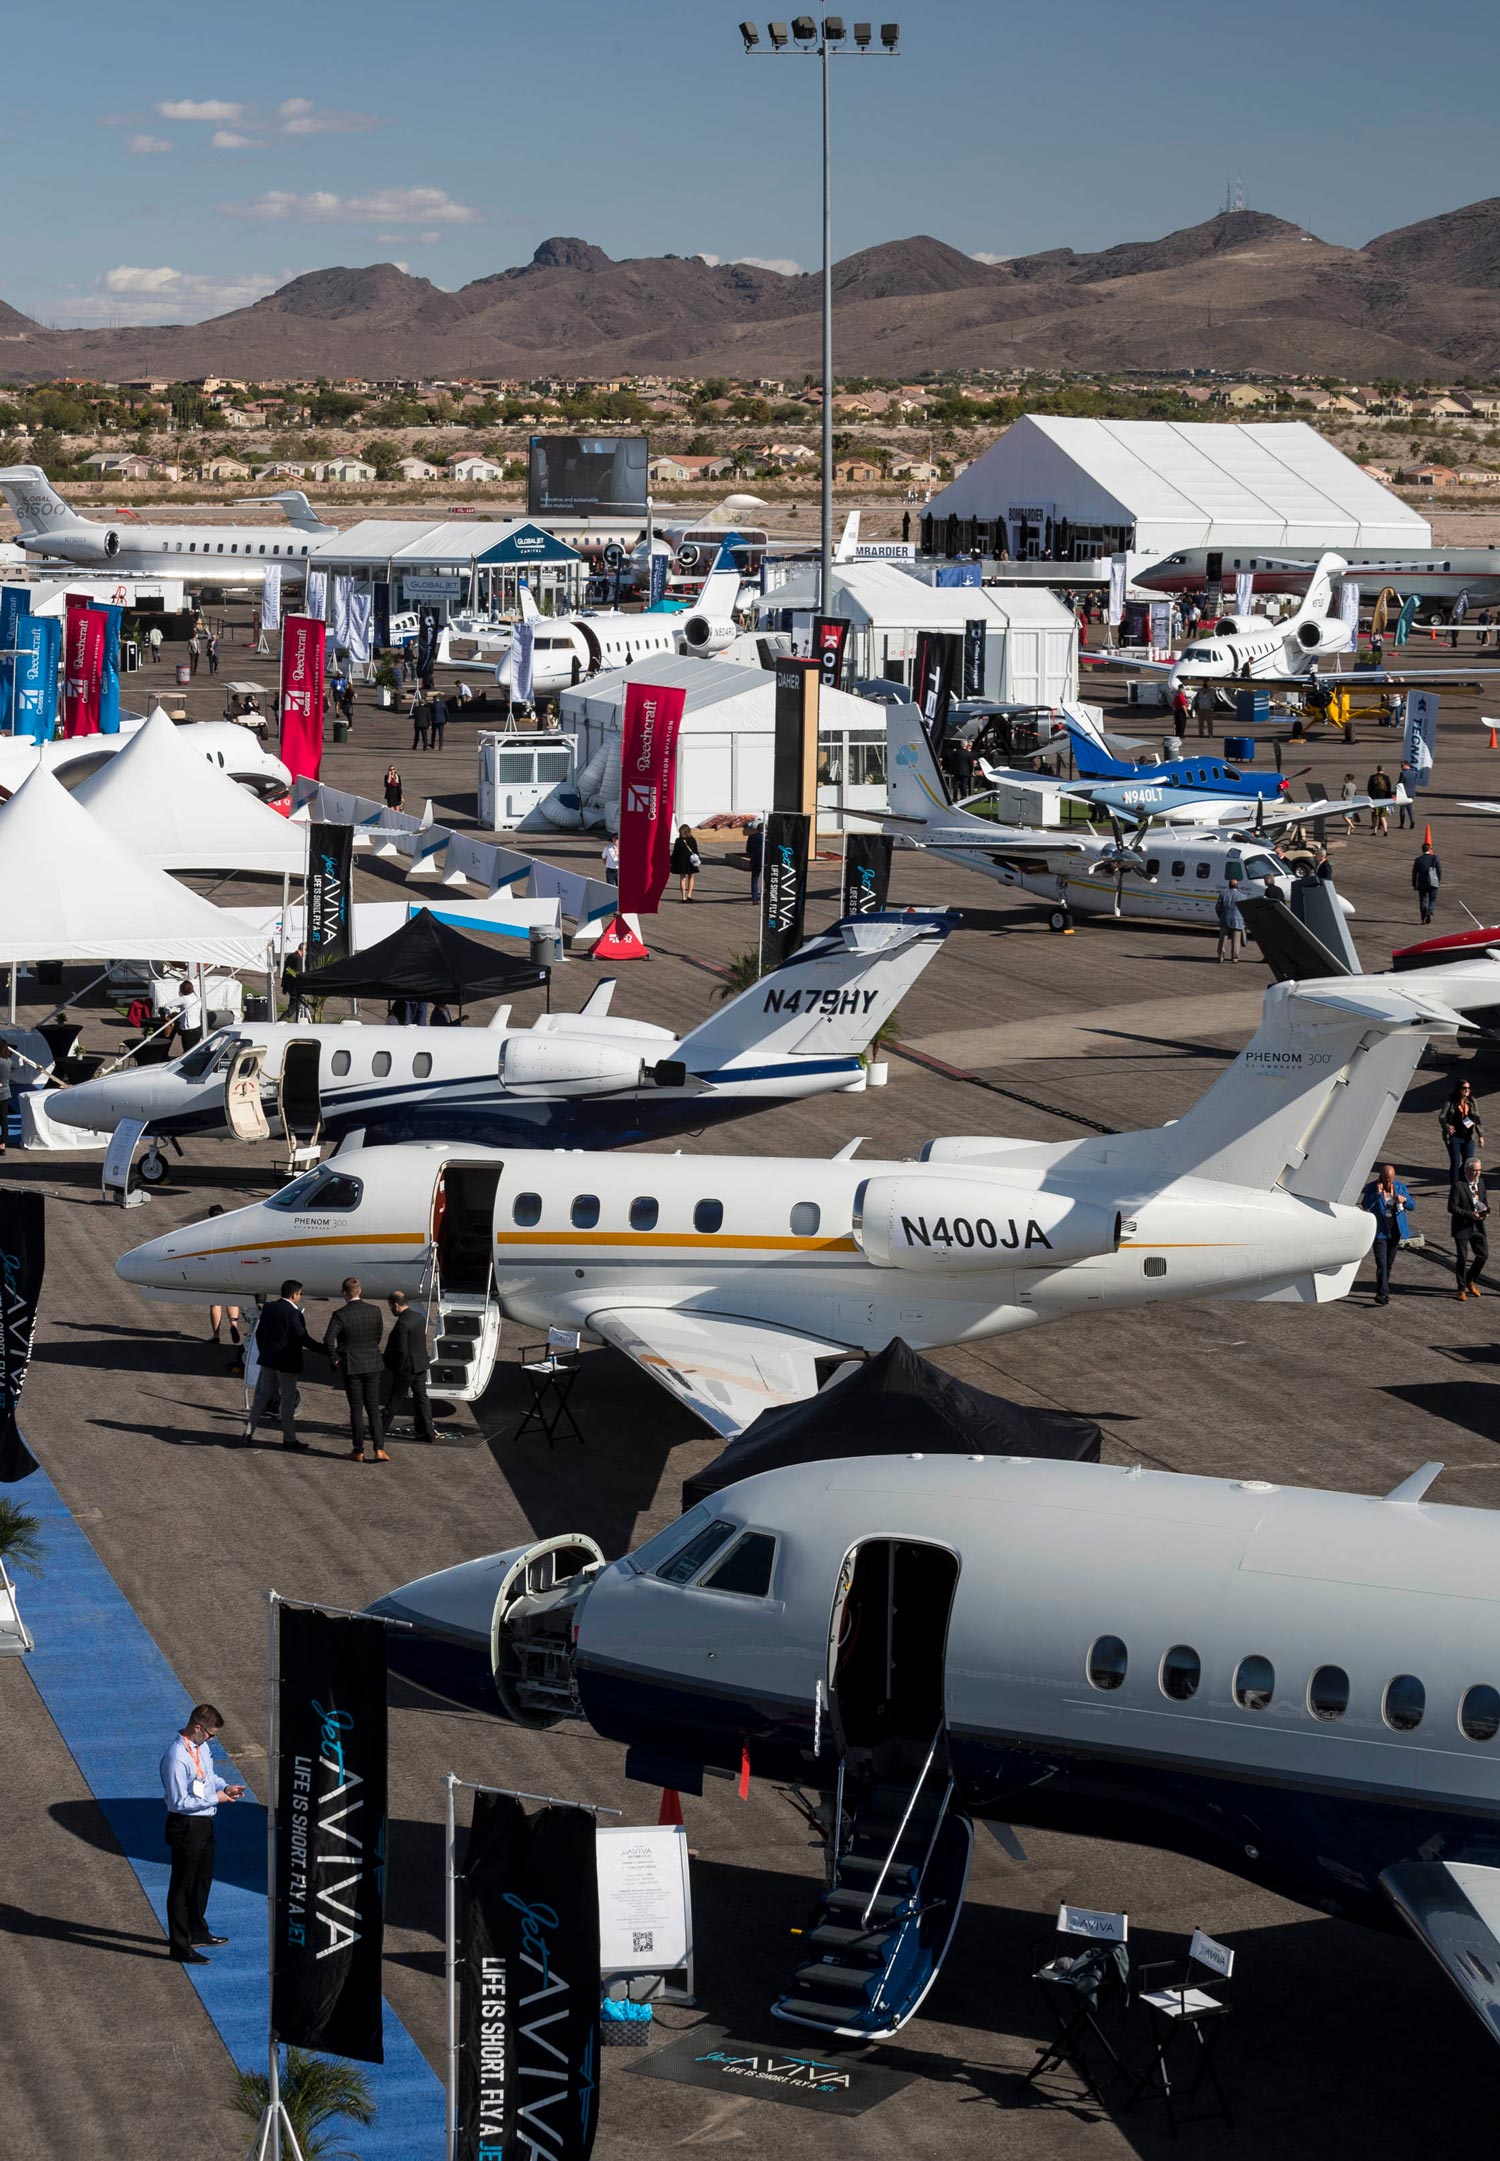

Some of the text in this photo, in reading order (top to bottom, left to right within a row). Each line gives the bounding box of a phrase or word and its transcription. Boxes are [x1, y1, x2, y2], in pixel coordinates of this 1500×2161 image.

[855, 546, 909, 557] MBARDIER
[27, 628, 41, 680] Beechcraft
[74, 619, 89, 670] Beechcraft
[292, 628, 307, 682] Beechcraft
[81, 679, 89, 704] Cessna
[777, 672, 800, 690] DAHER
[36, 689, 44, 715] Cessna
[303, 691, 311, 717] Cessna
[636, 699, 657, 772] Beechcraft
[666, 720, 674, 755] AVIATION
[648, 786, 657, 821] Cessna
[1124, 788, 1163, 804] N940LT
[763, 989, 879, 1015] N479HY
[1246, 1052, 1302, 1063] PHENOM
[294, 1217, 331, 1226] PHENOM
[901, 1216, 1053, 1250] N400JA
[294, 1755, 312, 1792] LIFE
[293, 1794, 309, 1812] IS
[290, 1814, 308, 1872] SHORT.
[289, 1875, 306, 1902] FLY
[288, 1902, 306, 1914] A
[478, 1957, 506, 2161] LIFE IS SHORT. FLY A JE
[722, 2065, 743, 2075] LIFE
[743, 2068, 757, 2077] IS
[789, 2078, 812, 2088] FLY
[807, 2081, 817, 2090] A
